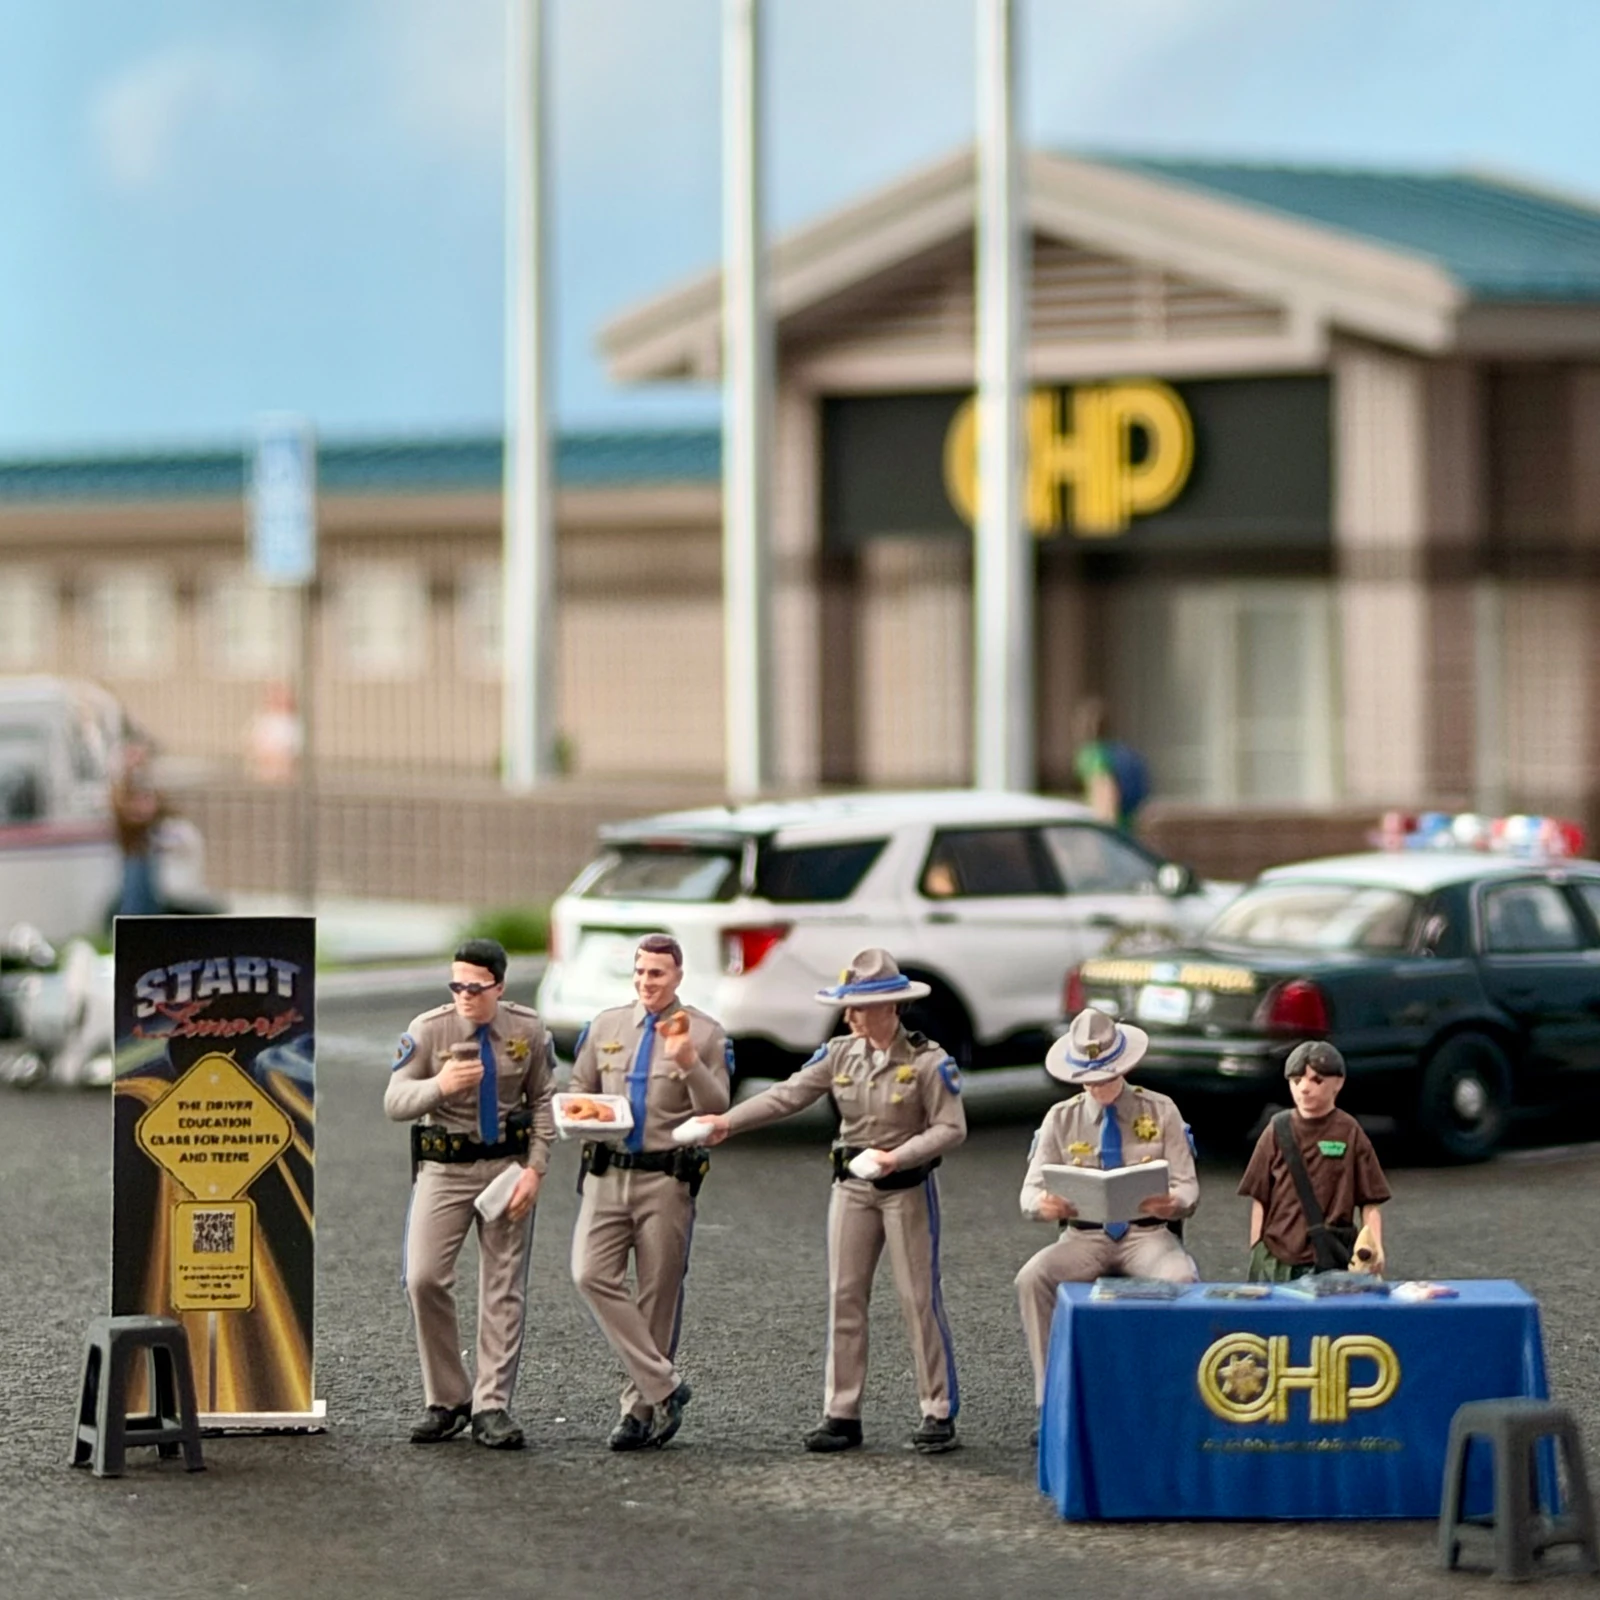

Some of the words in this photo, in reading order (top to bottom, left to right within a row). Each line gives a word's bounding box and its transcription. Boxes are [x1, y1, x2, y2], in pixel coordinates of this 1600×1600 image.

[133, 955, 302, 1019] START
[177, 1100, 202, 1111] THE
[205, 1100, 254, 1111] DRIVER
[178, 1117, 252, 1129] EDUCATION
[150, 1133, 191, 1146] CLASS
[193, 1133, 220, 1146] FOR
[221, 1133, 280, 1146] PARENTS
[179, 1151, 208, 1163] AND
[210, 1151, 250, 1163] TEENS
[1197, 1331, 1400, 1425] CHP
